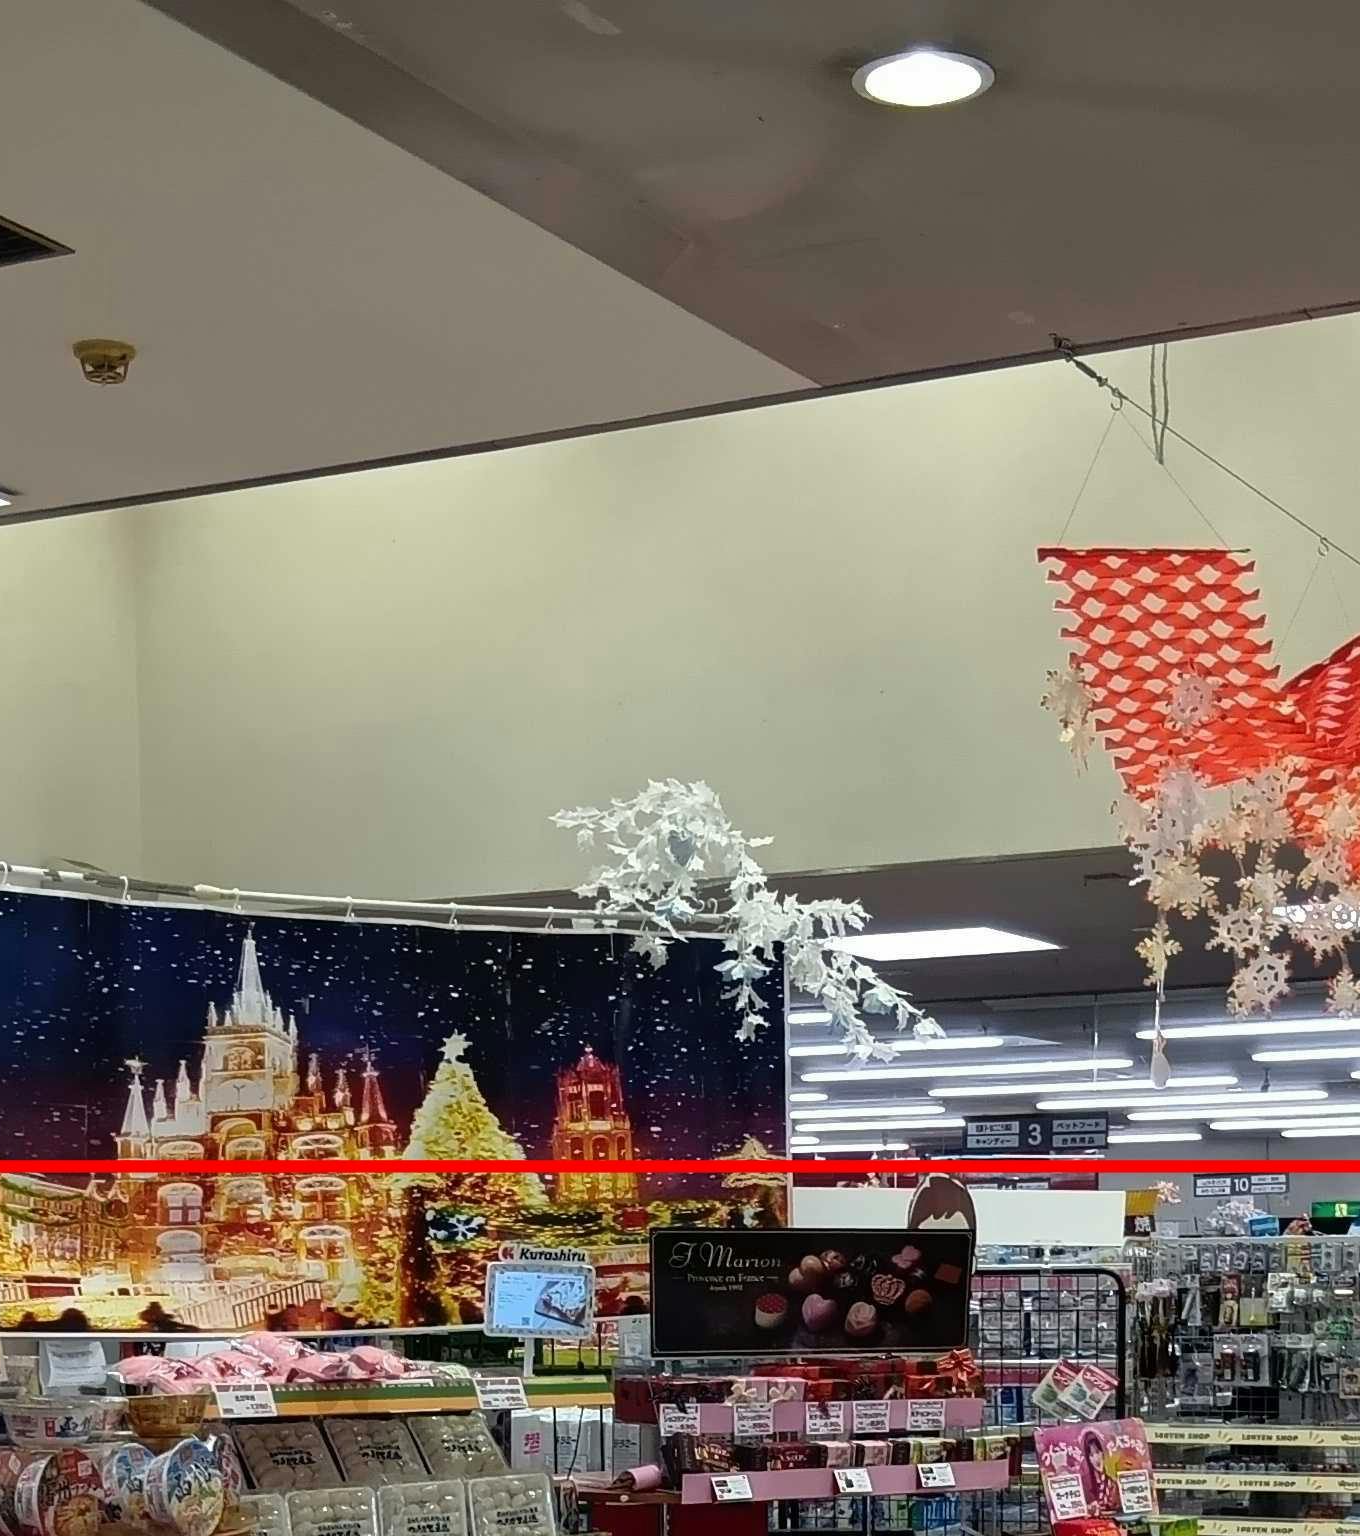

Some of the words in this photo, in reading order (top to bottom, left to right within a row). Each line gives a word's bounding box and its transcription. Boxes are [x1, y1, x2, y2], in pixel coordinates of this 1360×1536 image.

[1028, 1123, 1041, 1145] 3
[1234, 1178, 1249, 1192] 10
[520, 1248, 586, 1261] Kurashiru
